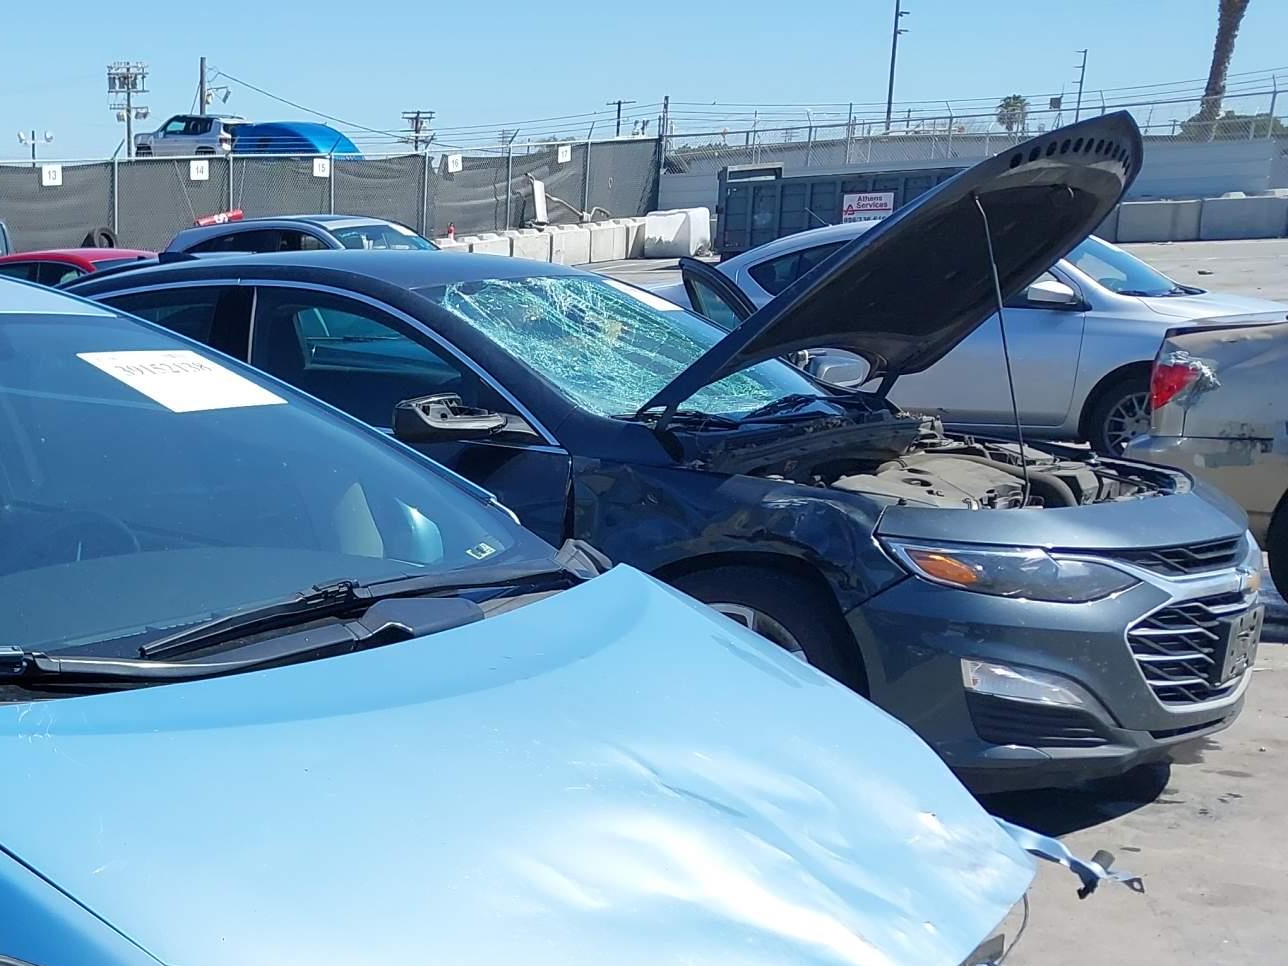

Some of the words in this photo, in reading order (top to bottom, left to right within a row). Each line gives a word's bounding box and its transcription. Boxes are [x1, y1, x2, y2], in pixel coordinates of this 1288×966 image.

[561, 150, 569, 159] 17
[317, 162, 327, 173] 15
[451, 158, 460, 168] 16
[47, 169, 57, 181] 13
[195, 165, 205, 176] 14
[114, 361, 213, 376] 39152138
